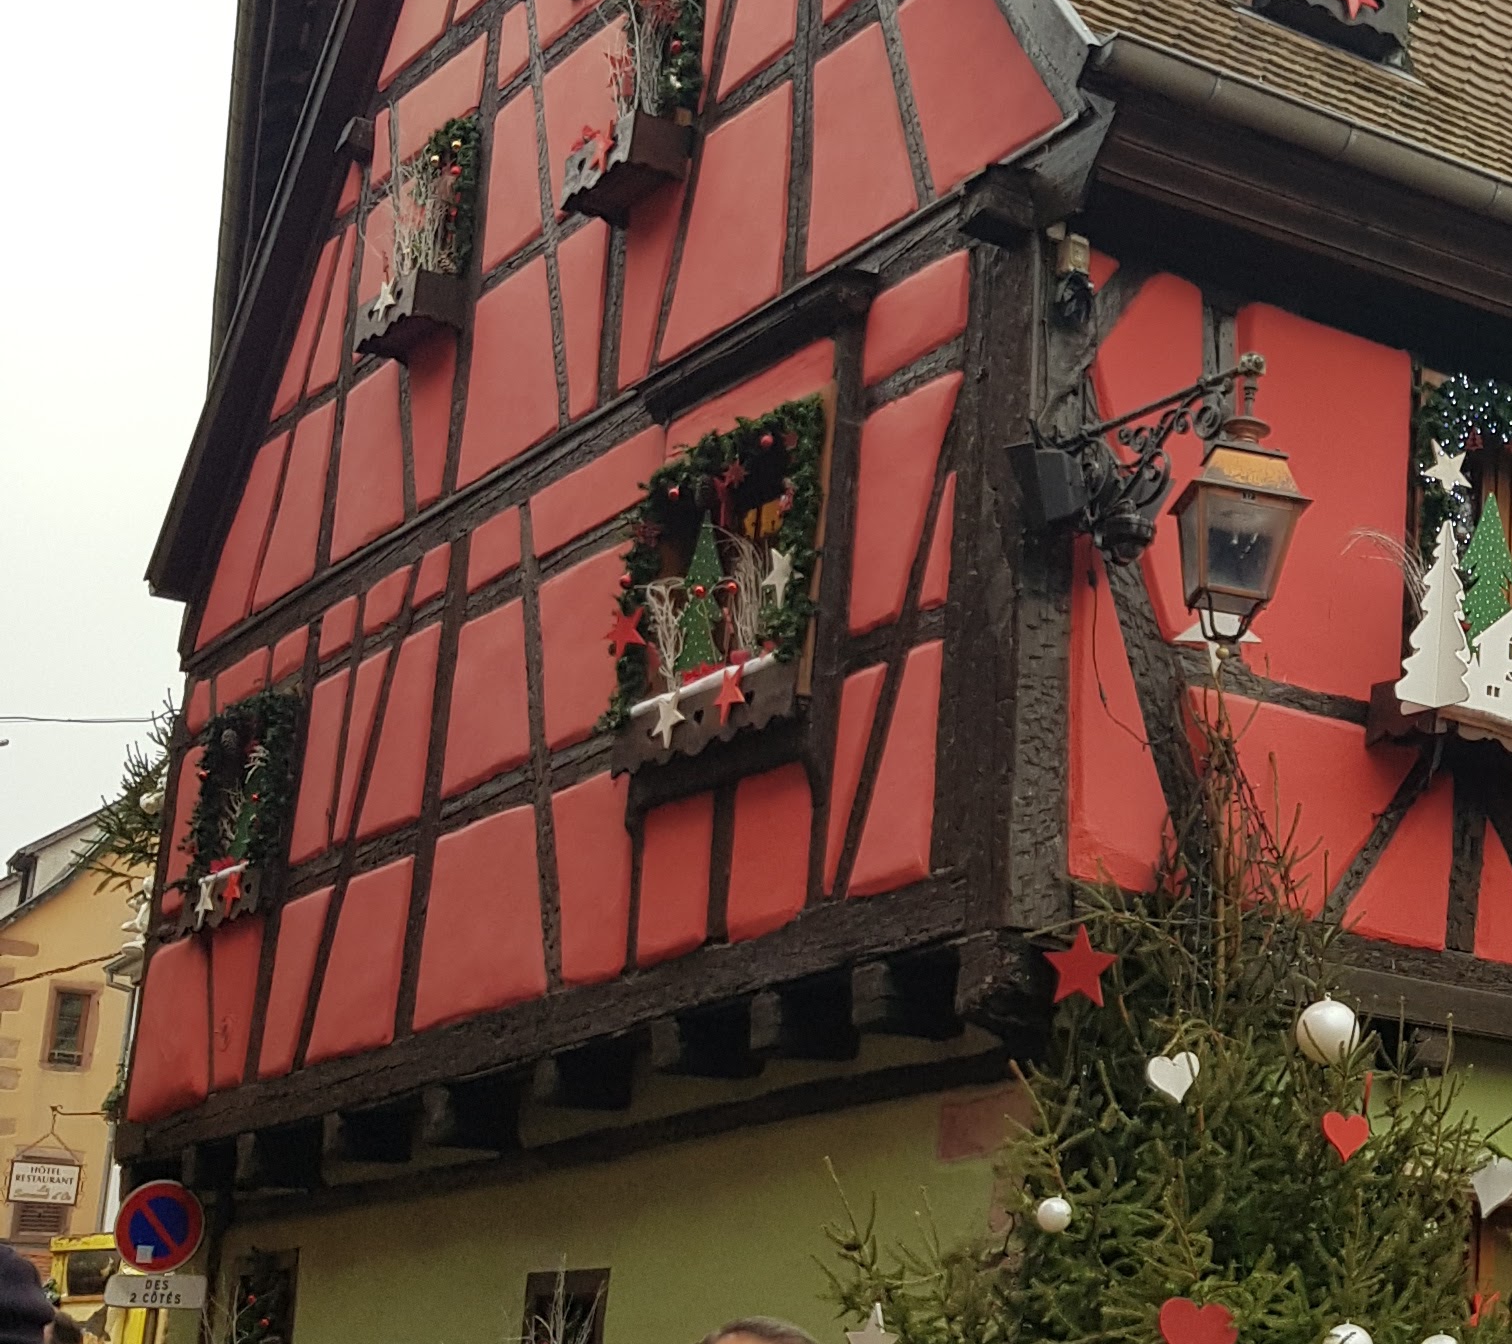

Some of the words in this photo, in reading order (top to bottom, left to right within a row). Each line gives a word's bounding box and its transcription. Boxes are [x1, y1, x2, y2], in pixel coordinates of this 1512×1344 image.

[30, 1165, 60, 1176] HÔTEL
[15, 1174, 74, 1185] RESTAURANT
[145, 1279, 169, 1291] DES
[129, 1292, 137, 1303] 2
[142, 1290, 181, 1304] CÔTÉS
